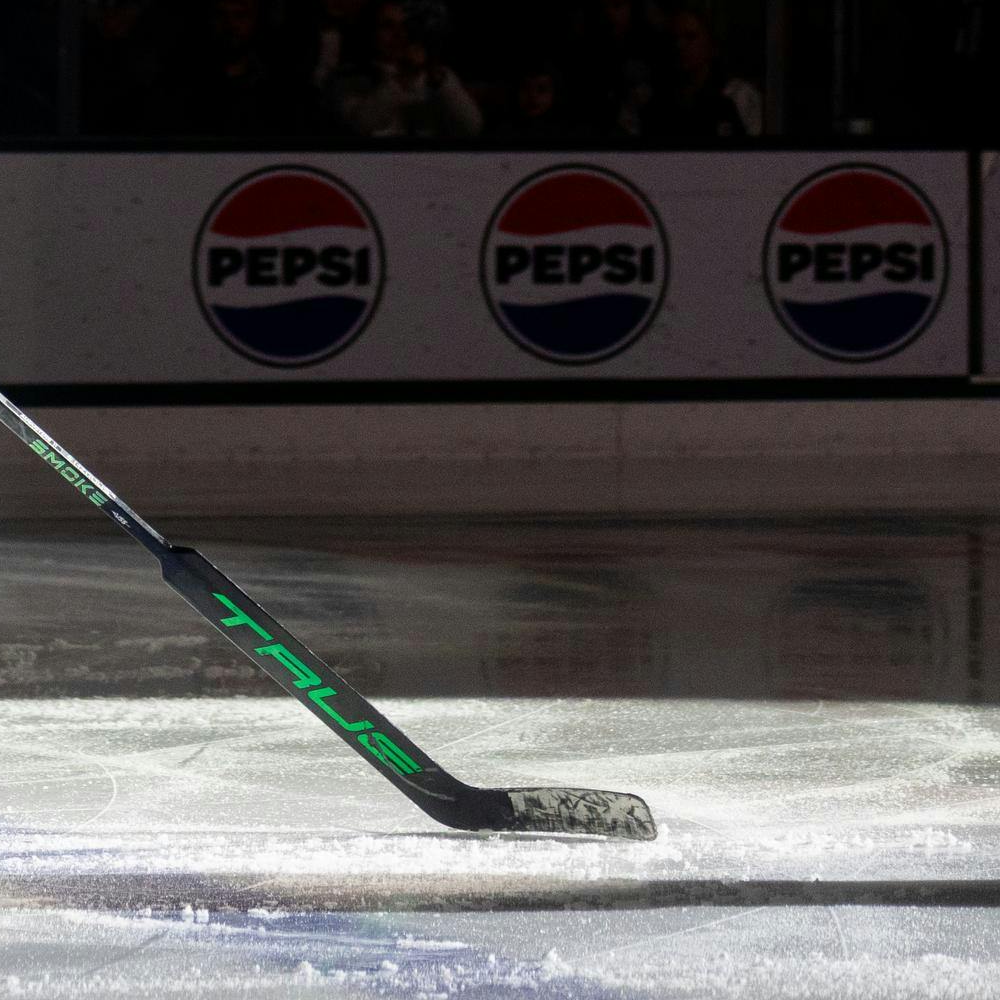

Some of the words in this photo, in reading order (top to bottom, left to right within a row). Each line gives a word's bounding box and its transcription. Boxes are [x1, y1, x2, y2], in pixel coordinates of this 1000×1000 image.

[209, 246, 370, 287] PEPSI
[496, 245, 654, 285] PEPSI
[778, 243, 934, 282] PEPSI
[29, 438, 108, 507] SMOKE
[212, 592, 424, 776] TRUE
